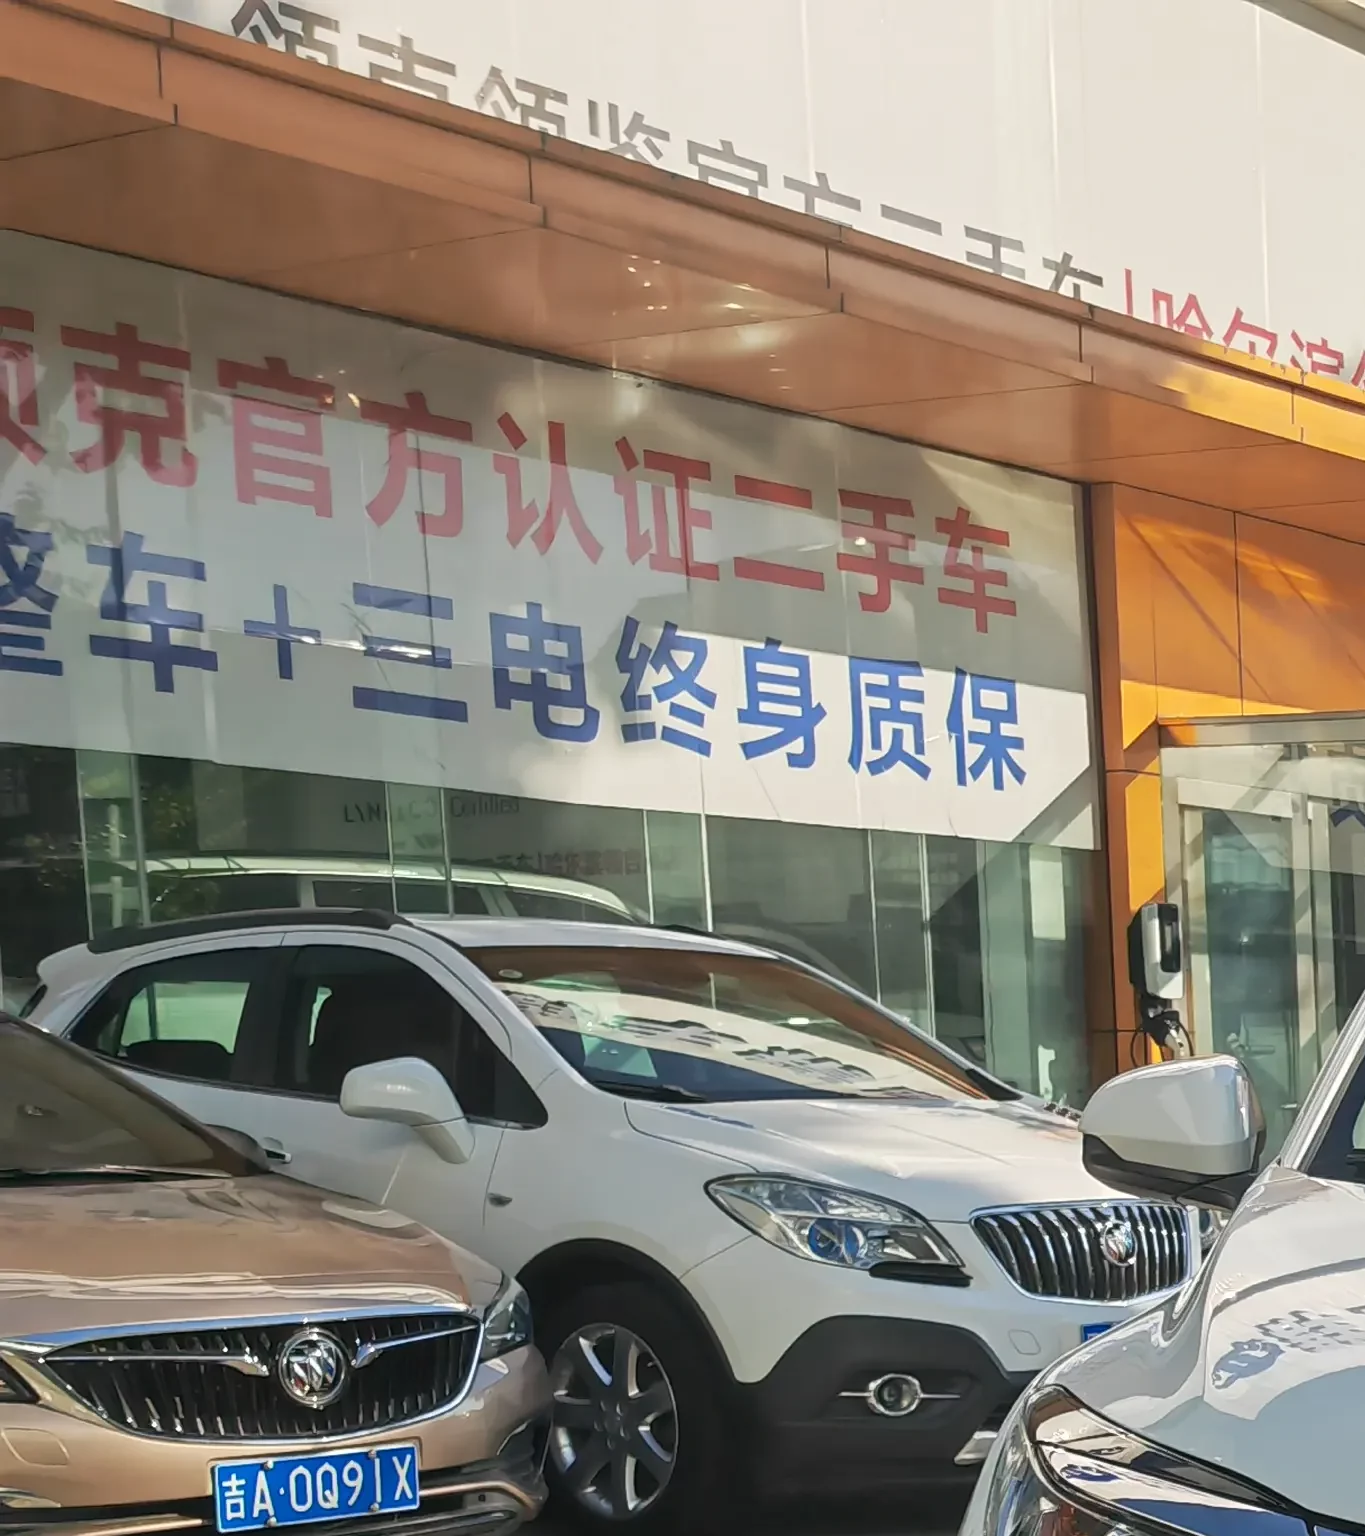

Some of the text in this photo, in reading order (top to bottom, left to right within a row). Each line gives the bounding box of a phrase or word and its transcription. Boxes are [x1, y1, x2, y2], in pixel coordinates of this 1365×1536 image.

[0, 307, 1018, 634] 克官方认证二手车
